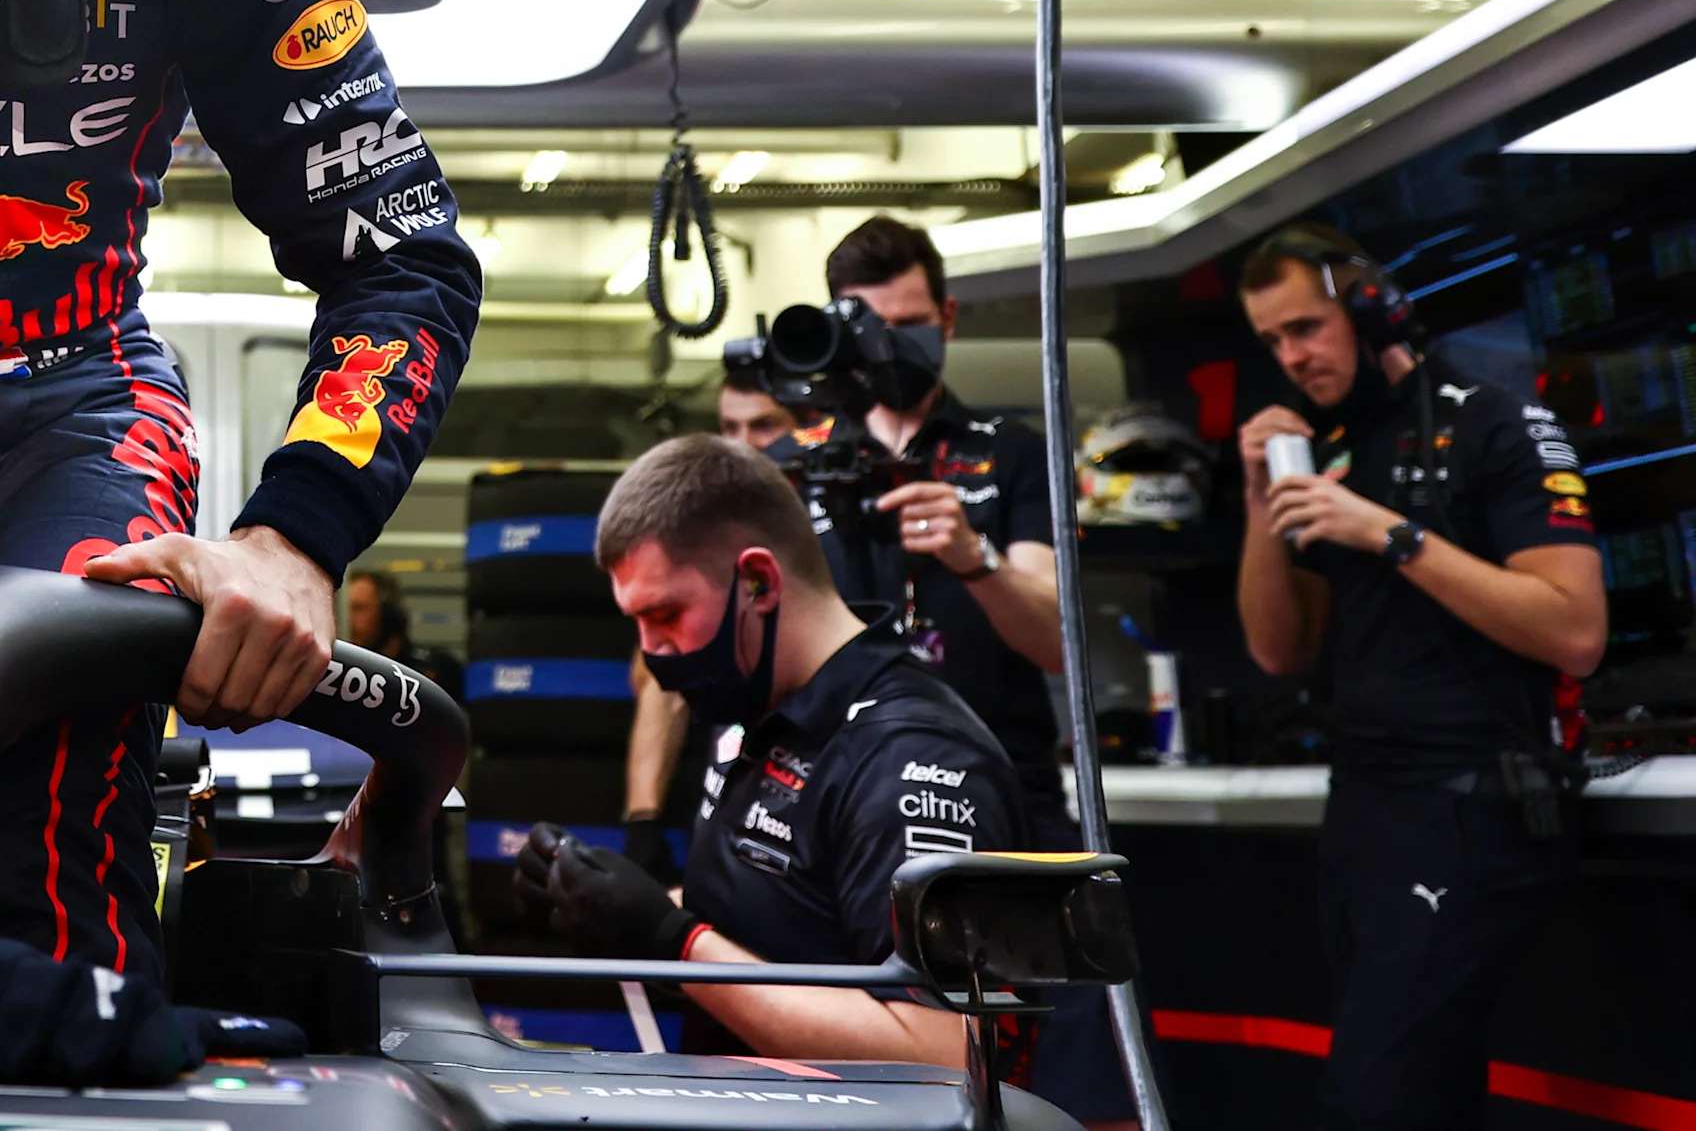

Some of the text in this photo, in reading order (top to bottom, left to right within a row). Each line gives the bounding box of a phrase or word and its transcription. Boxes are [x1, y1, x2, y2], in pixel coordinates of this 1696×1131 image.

[301, 5, 358, 53] RAUCH
[306, 107, 423, 192] HRC
[308, 147, 427, 204] Honda RACING
[376, 180, 440, 223] ARCTIC
[390, 207, 449, 237] WOLF
[387, 327, 441, 434] Red Bull
[314, 661, 386, 709] zos
[901, 761, 967, 788] telcel
[898, 790, 977, 827] citrix
[581, 1086, 880, 1106] Walmart
